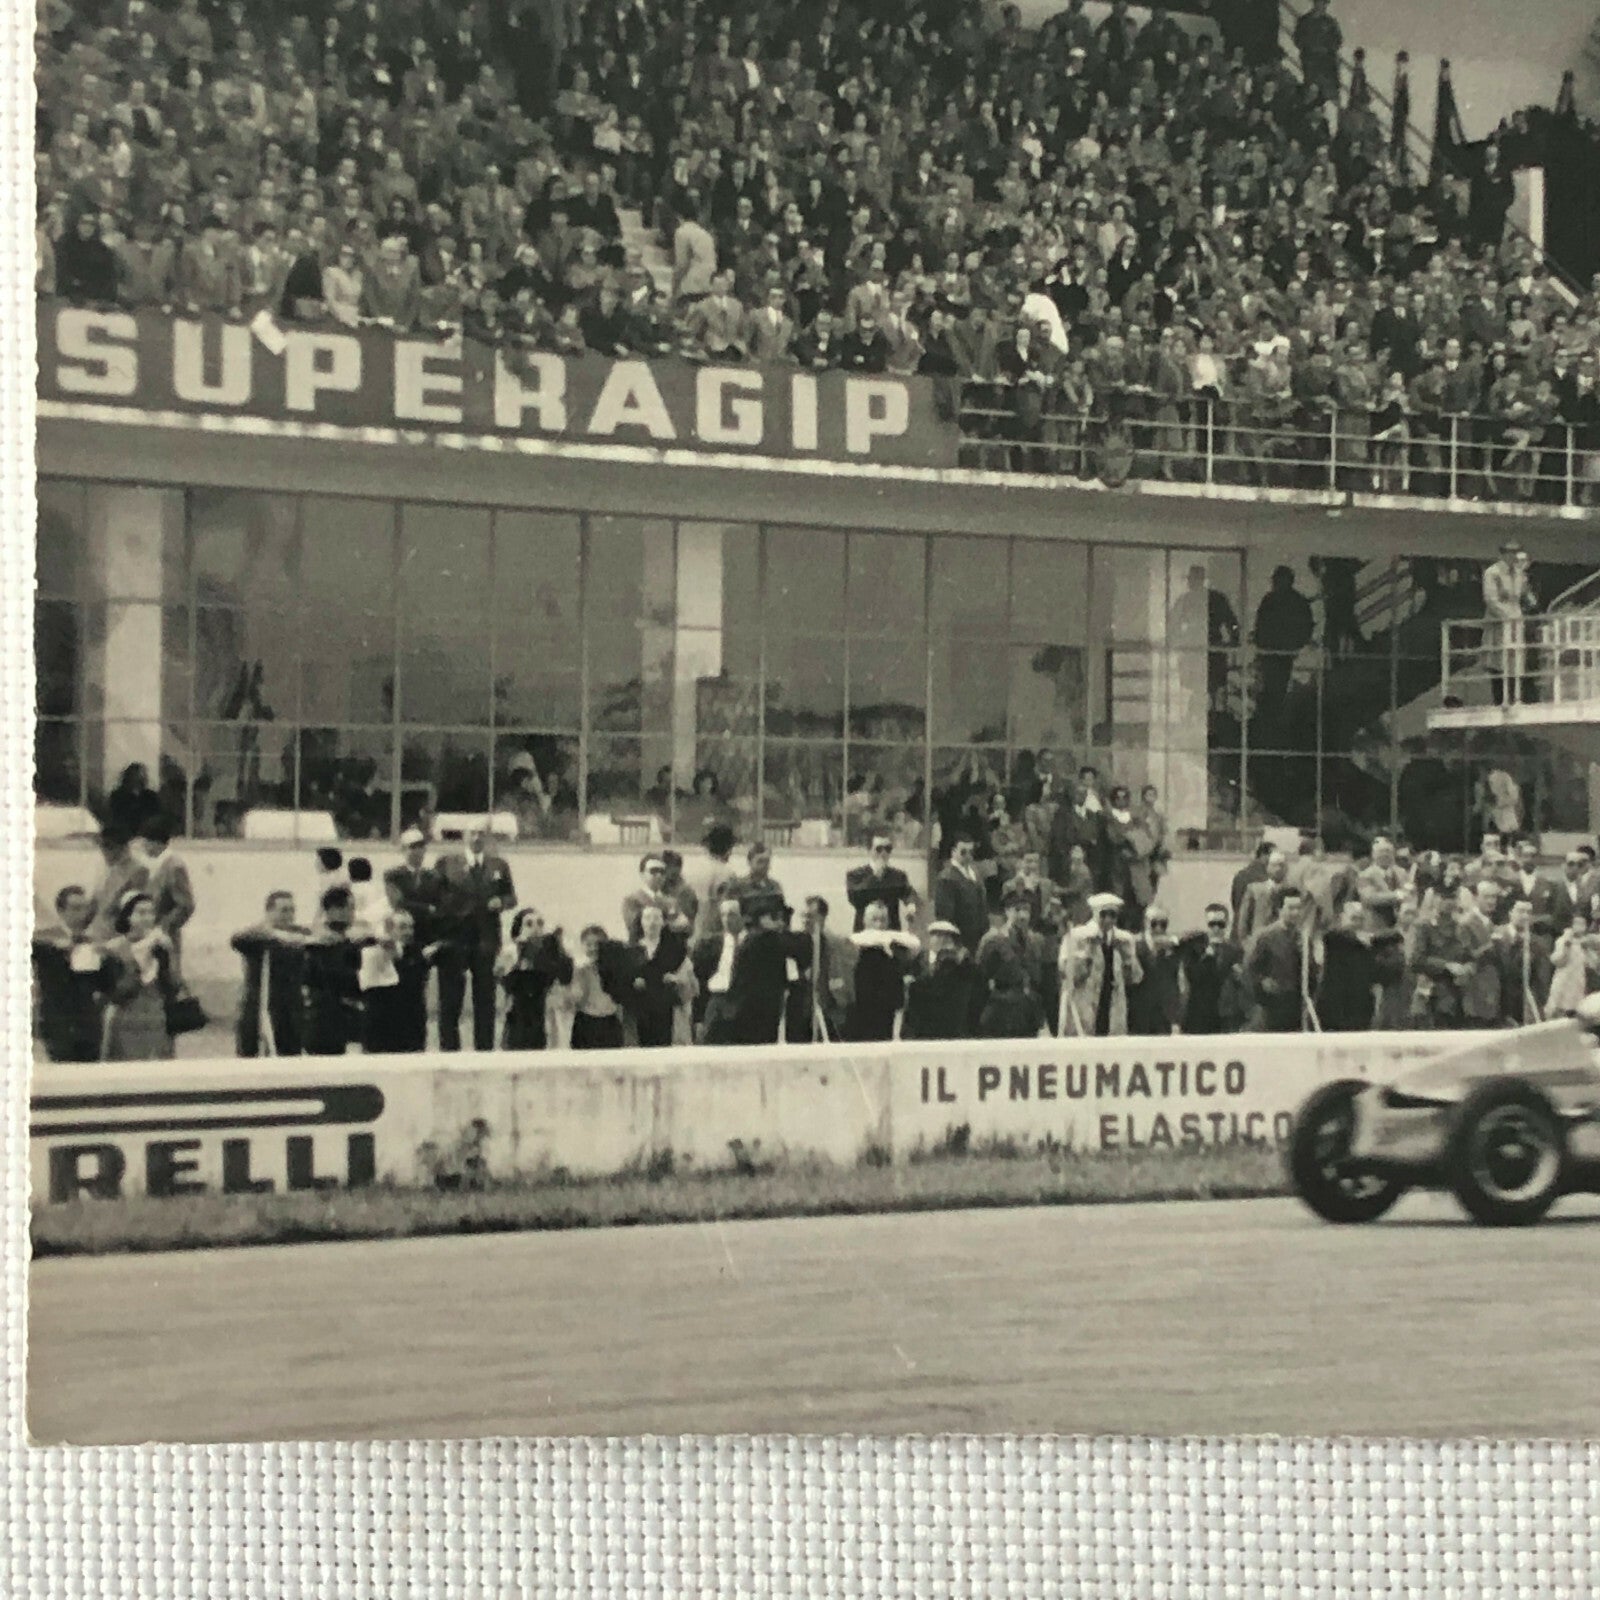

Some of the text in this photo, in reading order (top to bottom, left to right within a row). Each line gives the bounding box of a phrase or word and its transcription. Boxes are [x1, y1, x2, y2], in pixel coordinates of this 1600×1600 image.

[56, 306, 910, 456] SUPERAGIP
[921, 1060, 1247, 1103] IL PNEUMATICO
[1100, 1111, 1293, 1151] ELASTICO
